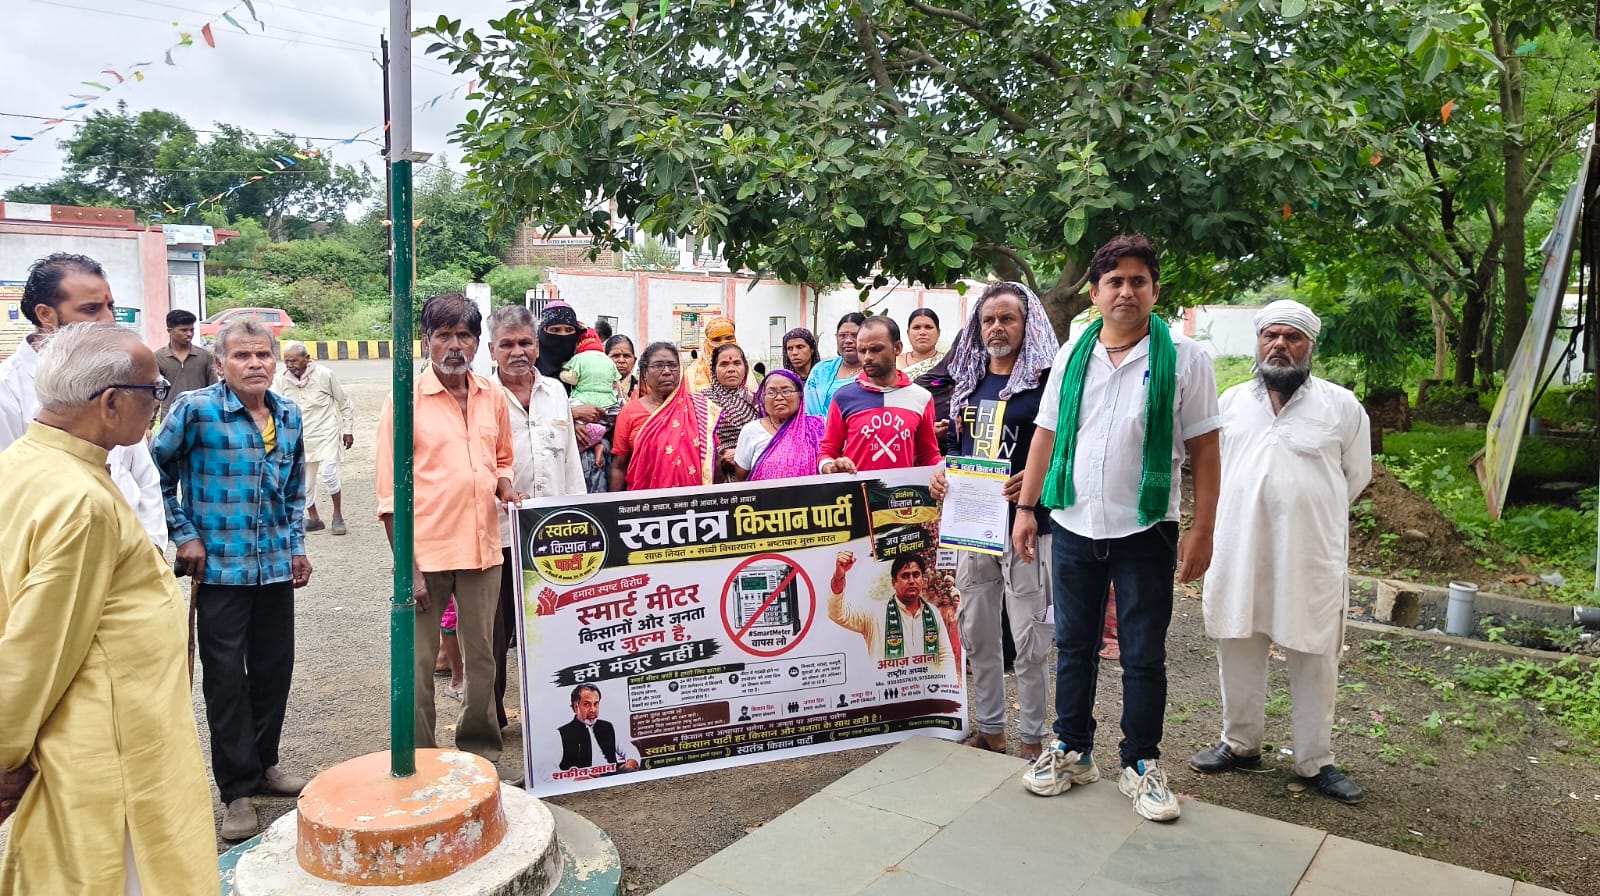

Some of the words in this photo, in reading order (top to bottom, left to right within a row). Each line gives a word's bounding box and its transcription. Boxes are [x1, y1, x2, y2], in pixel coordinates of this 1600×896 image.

[861, 411, 911, 441] ROOTS
[618, 503, 641, 514] किसानों
[642, 503, 650, 512] की
[673, 501, 689, 509] जनता
[690, 499, 698, 508] की
[720, 496, 729, 505] देश
[730, 495, 738, 504] की
[890, 498, 913, 508] किसान
[617, 508, 730, 550] स्वतंत्र
[733, 504, 808, 536] किसान
[811, 493, 853, 529] पार्टी
[766, 538, 797, 549] भ्रष्टाचार
[799, 536, 815, 547] मुक्त
[817, 534, 836, 544] भारत
[886, 536, 899, 546] जय
[900, 531, 920, 542] जवान
[550, 540, 587, 554] किसान
[664, 548, 686, 558] नियत
[697, 544, 718, 555] सच्ची
[719, 542, 756, 553] विचारधारा
[883, 546, 897, 557] जय
[898, 541, 924, 554] किसान
[554, 553, 584, 572] पार्टी
[571, 588, 596, 600] हमारा
[597, 583, 618, 596] स्पष्ट
[620, 577, 643, 590] विरोध
[576, 590, 638, 626] स्मार्ट
[645, 584, 700, 611] मीटर
[578, 618, 633, 645] किसानों
[637, 614, 664, 631] और
[668, 607, 705, 625] जनता
[749, 629, 791, 637] #SmartMeter
[596, 640, 616, 653] पर
[620, 630, 665, 654] जुल्म
[672, 624, 692, 642] है,
[751, 638, 774, 648] वापस
[775, 635, 787, 646] लो
[573, 662, 600, 683] हमें
[609, 656, 653, 674] मंजूर
[659, 643, 696, 663] नहीं
[877, 656, 910, 670] अयाज़
[911, 653, 936, 664] खान
[887, 668, 907, 678] राष्ट्रीय
[908, 666, 928, 675] अध्यक्ष
[644, 743, 676, 756] स्वतंत्र
[678, 739, 711, 751] किसान
[713, 735, 732, 745] पार्टी
[735, 734, 746, 743] हर
[748, 730, 777, 740] किसान
[798, 723, 820, 733] जनता
[823, 720, 832, 729] के
[834, 719, 850, 728] साथ
[871, 713, 877, 723] है
[680, 733, 703, 742] किसान
[705, 730, 714, 738] पर
[766, 740, 794, 751] किसान
[797, 735, 814, 745] पार्टी
[552, 766, 588, 780] शकील
[589, 763, 616, 774] खान
